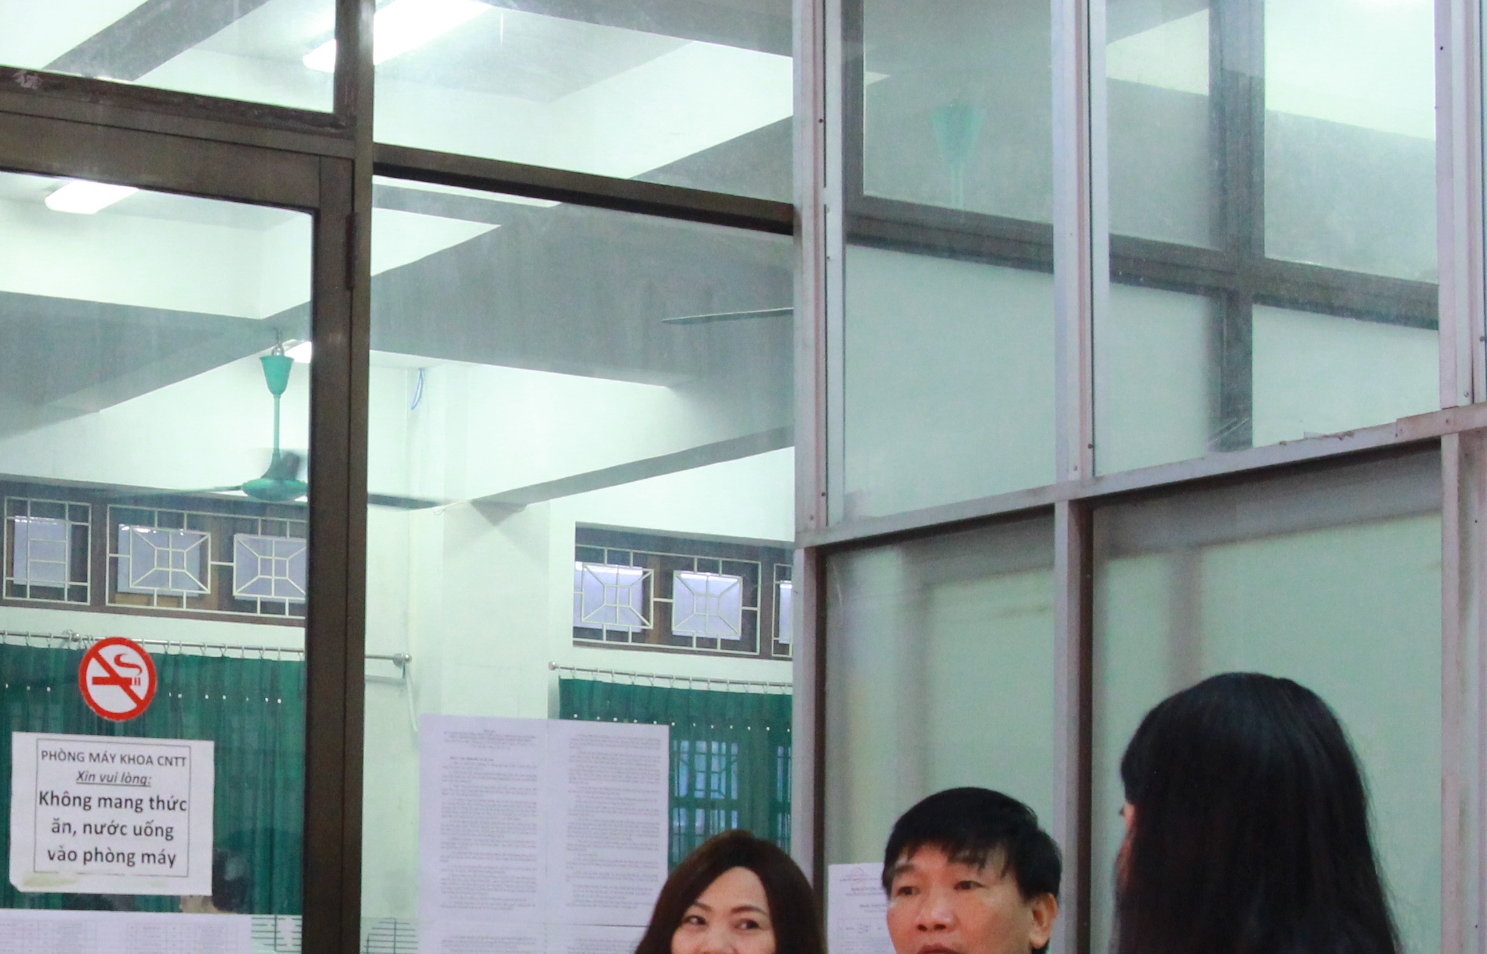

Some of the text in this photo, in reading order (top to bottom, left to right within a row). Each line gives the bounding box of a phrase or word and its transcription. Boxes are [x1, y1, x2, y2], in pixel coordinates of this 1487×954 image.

[41, 748, 187, 767] PHÒNG MÁY KHOA CNTT
[76, 770, 152, 787] Xin vui lòng:
[39, 790, 188, 814] Không mang thức
[51, 817, 175, 841] ăn, nước uống
[47, 845, 177, 869] vào phòng máy
